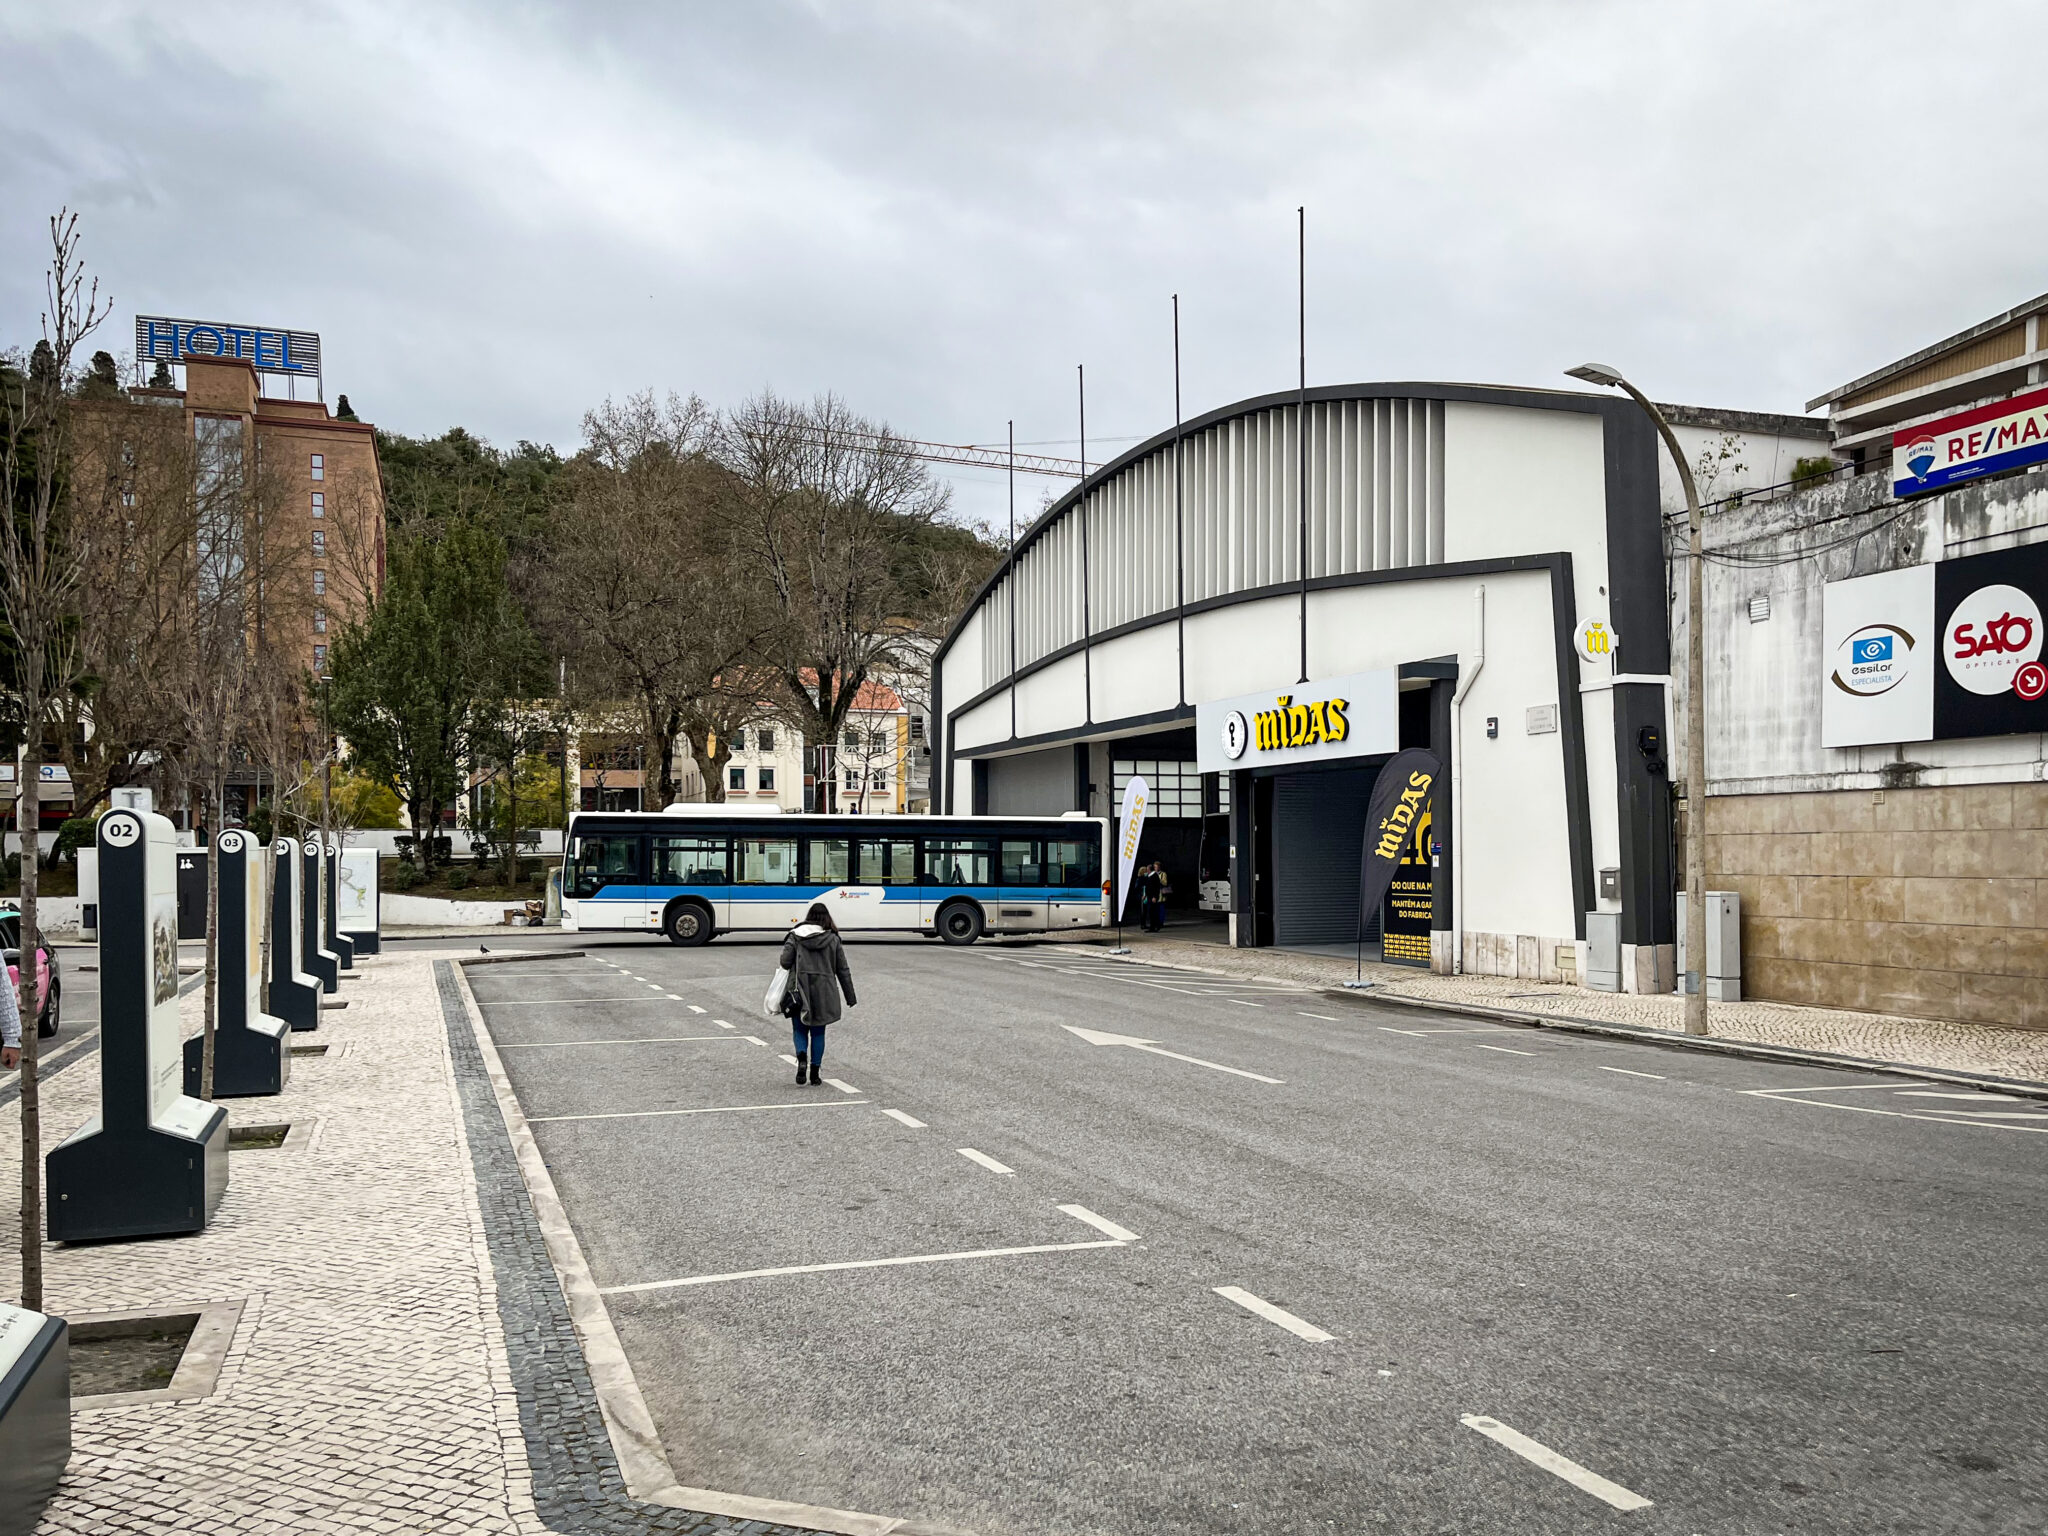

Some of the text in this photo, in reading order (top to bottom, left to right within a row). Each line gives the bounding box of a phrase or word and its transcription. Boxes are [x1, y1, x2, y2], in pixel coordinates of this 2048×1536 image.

[148, 321, 303, 370] HOTEL
[1908, 445, 1934, 458] RE/MAX
[1851, 663, 1893, 675] essilor
[1851, 675, 1893, 687] ESPECIALISTA
[109, 823, 133, 837] 02
[224, 838, 239, 848] 03
[1391, 881, 1401, 890] DO
[1402, 881, 1416, 890] QUE
[1416, 882, 1426, 891] NA
[1391, 898, 1416, 908] MANTÉM
[1416, 900, 1421, 909] A
[1398, 910, 1407, 918] DO
